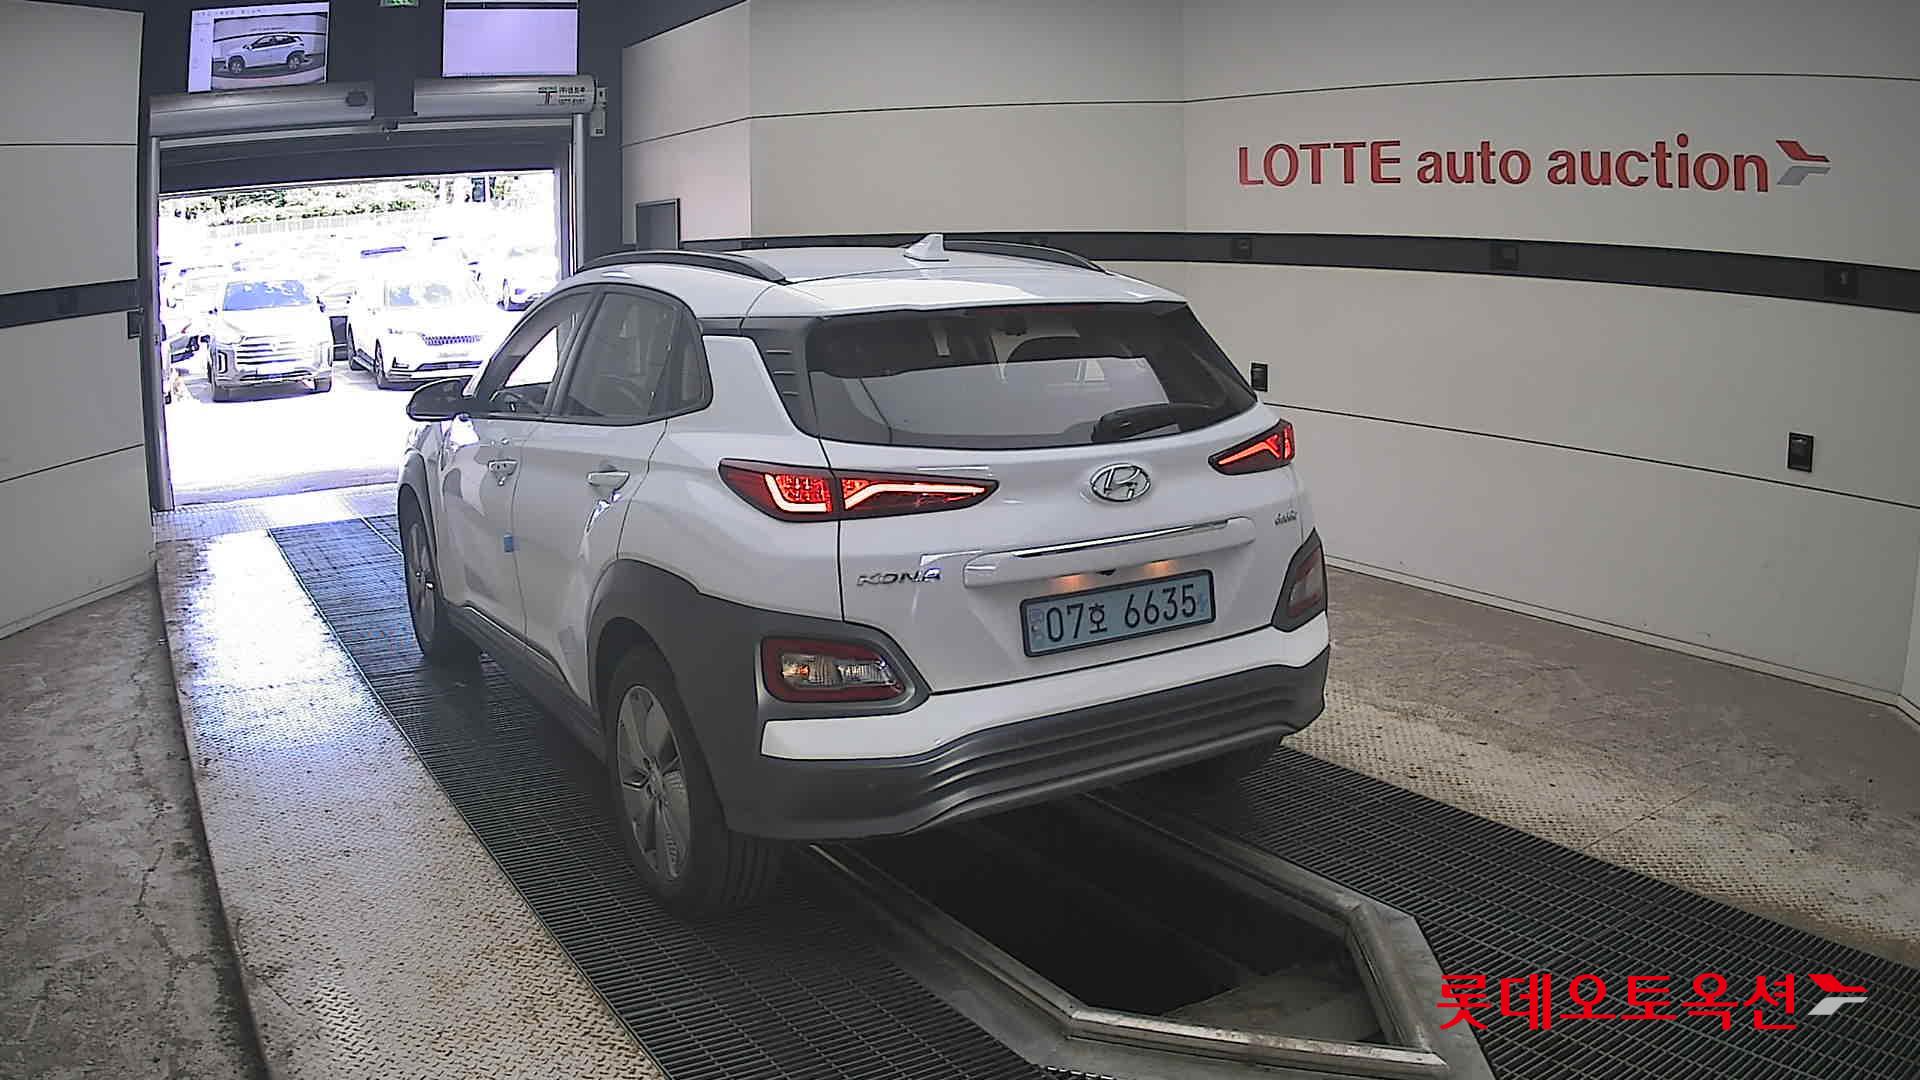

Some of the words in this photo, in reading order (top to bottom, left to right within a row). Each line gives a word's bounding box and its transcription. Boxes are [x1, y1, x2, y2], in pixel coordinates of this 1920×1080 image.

[1238, 140, 1401, 187] LOTTE
[1416, 141, 1532, 185] auto
[1547, 133, 1769, 193] auction
[857, 567, 941, 587] KONA
[1046, 602, 1107, 642] 07호
[1124, 583, 1197, 629] 6635
